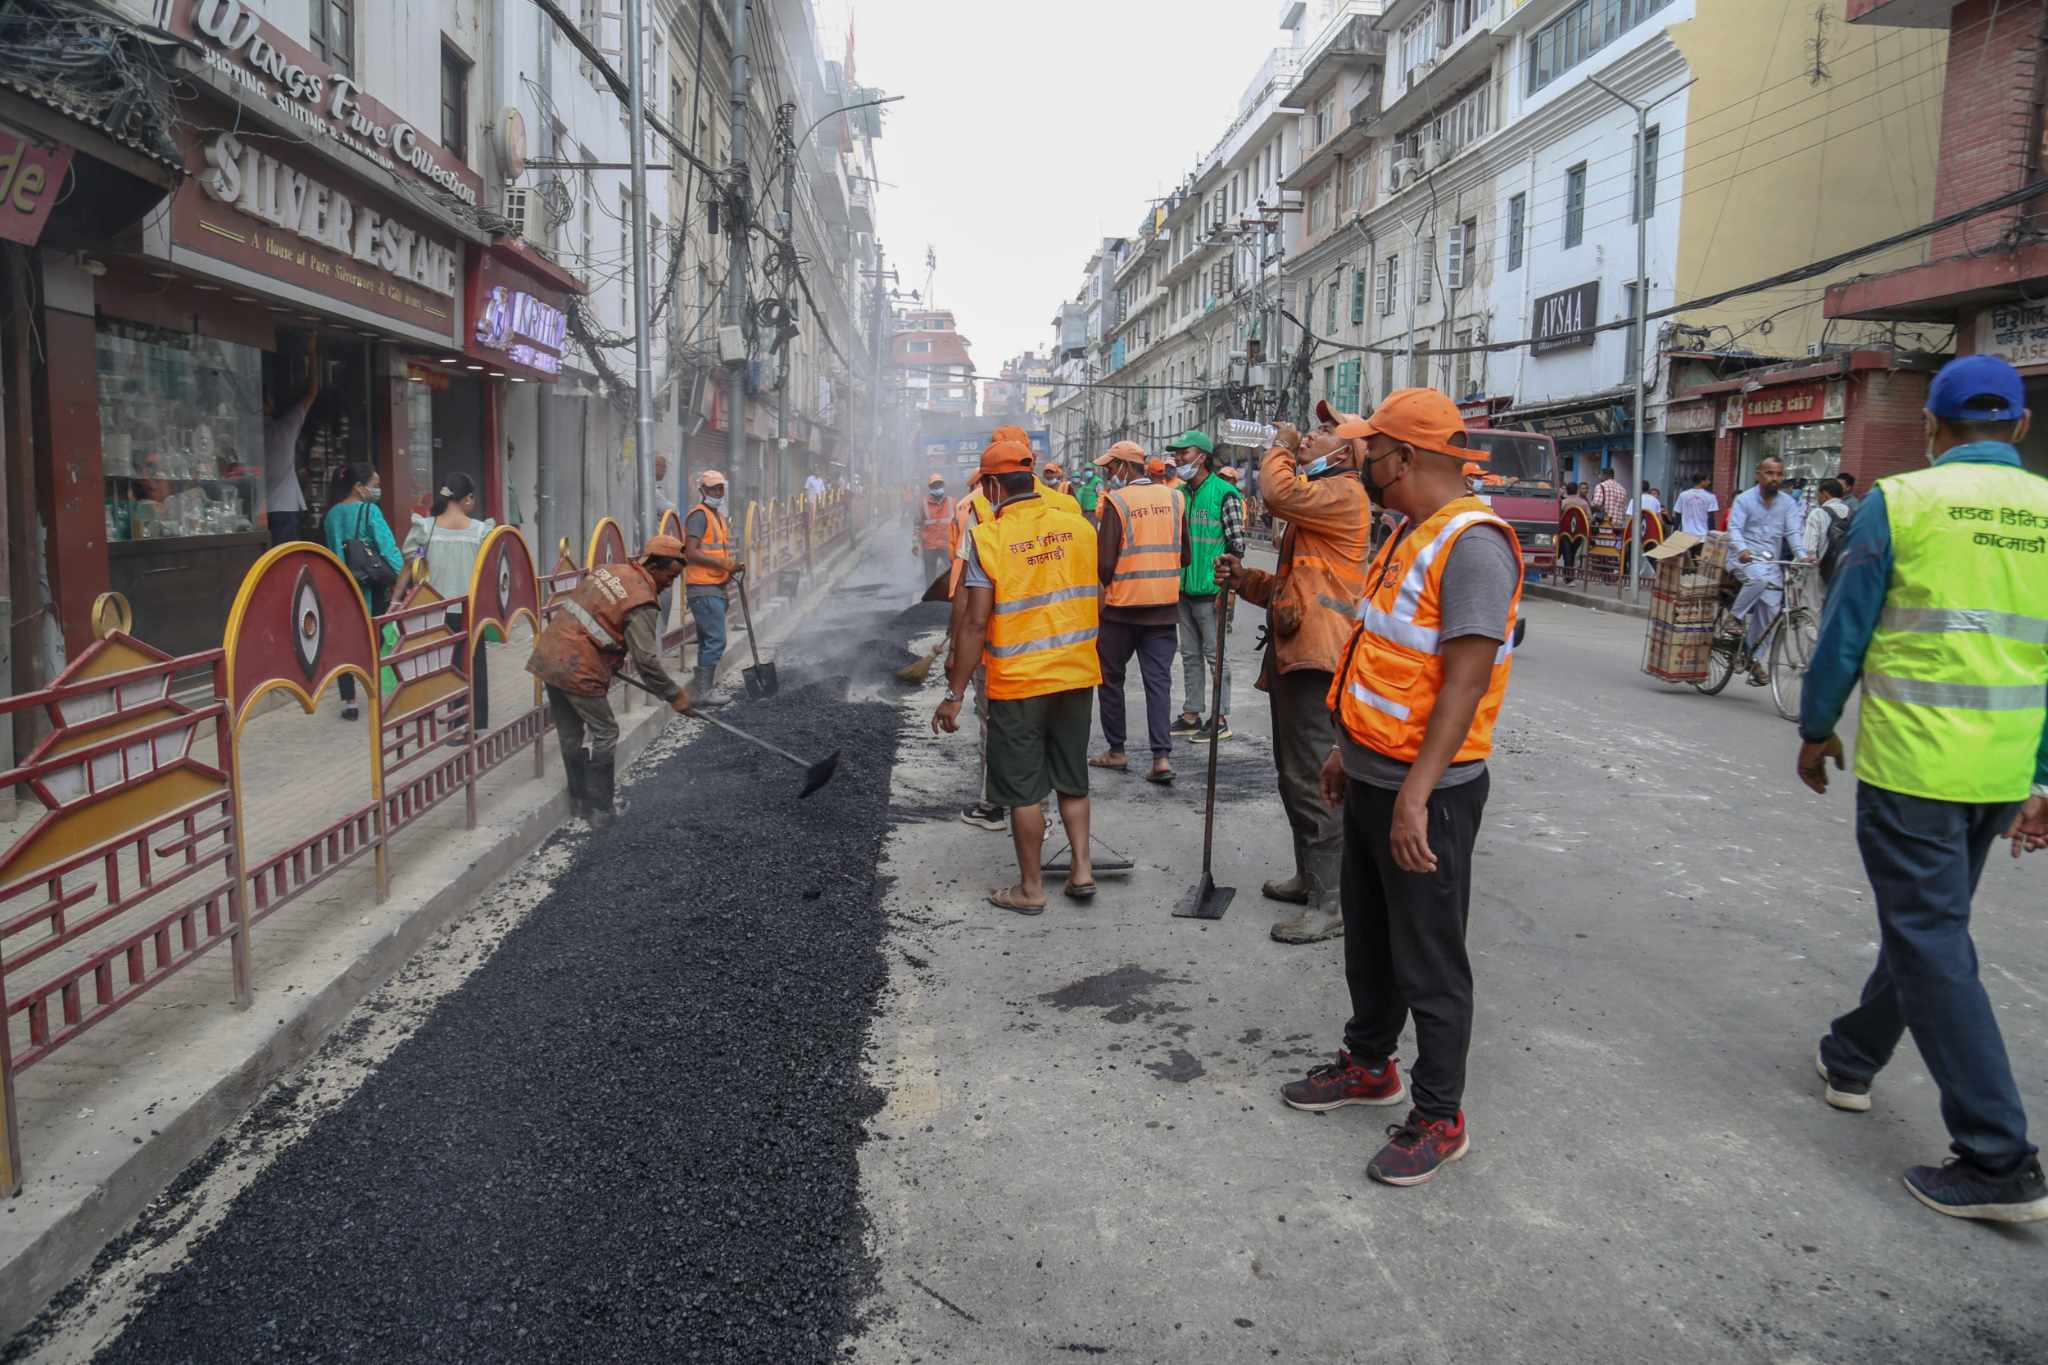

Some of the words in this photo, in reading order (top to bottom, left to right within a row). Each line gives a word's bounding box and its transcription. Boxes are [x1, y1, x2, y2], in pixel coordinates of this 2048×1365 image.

[197, 0, 323, 104] Wings
[327, 73, 392, 148] Five
[391, 123, 478, 206] Collection
[198, 131, 354, 256] SILVER
[351, 206, 457, 298] ESTATE
[264, 237, 293, 262] House
[1539, 290, 1583, 338] AVSAA
